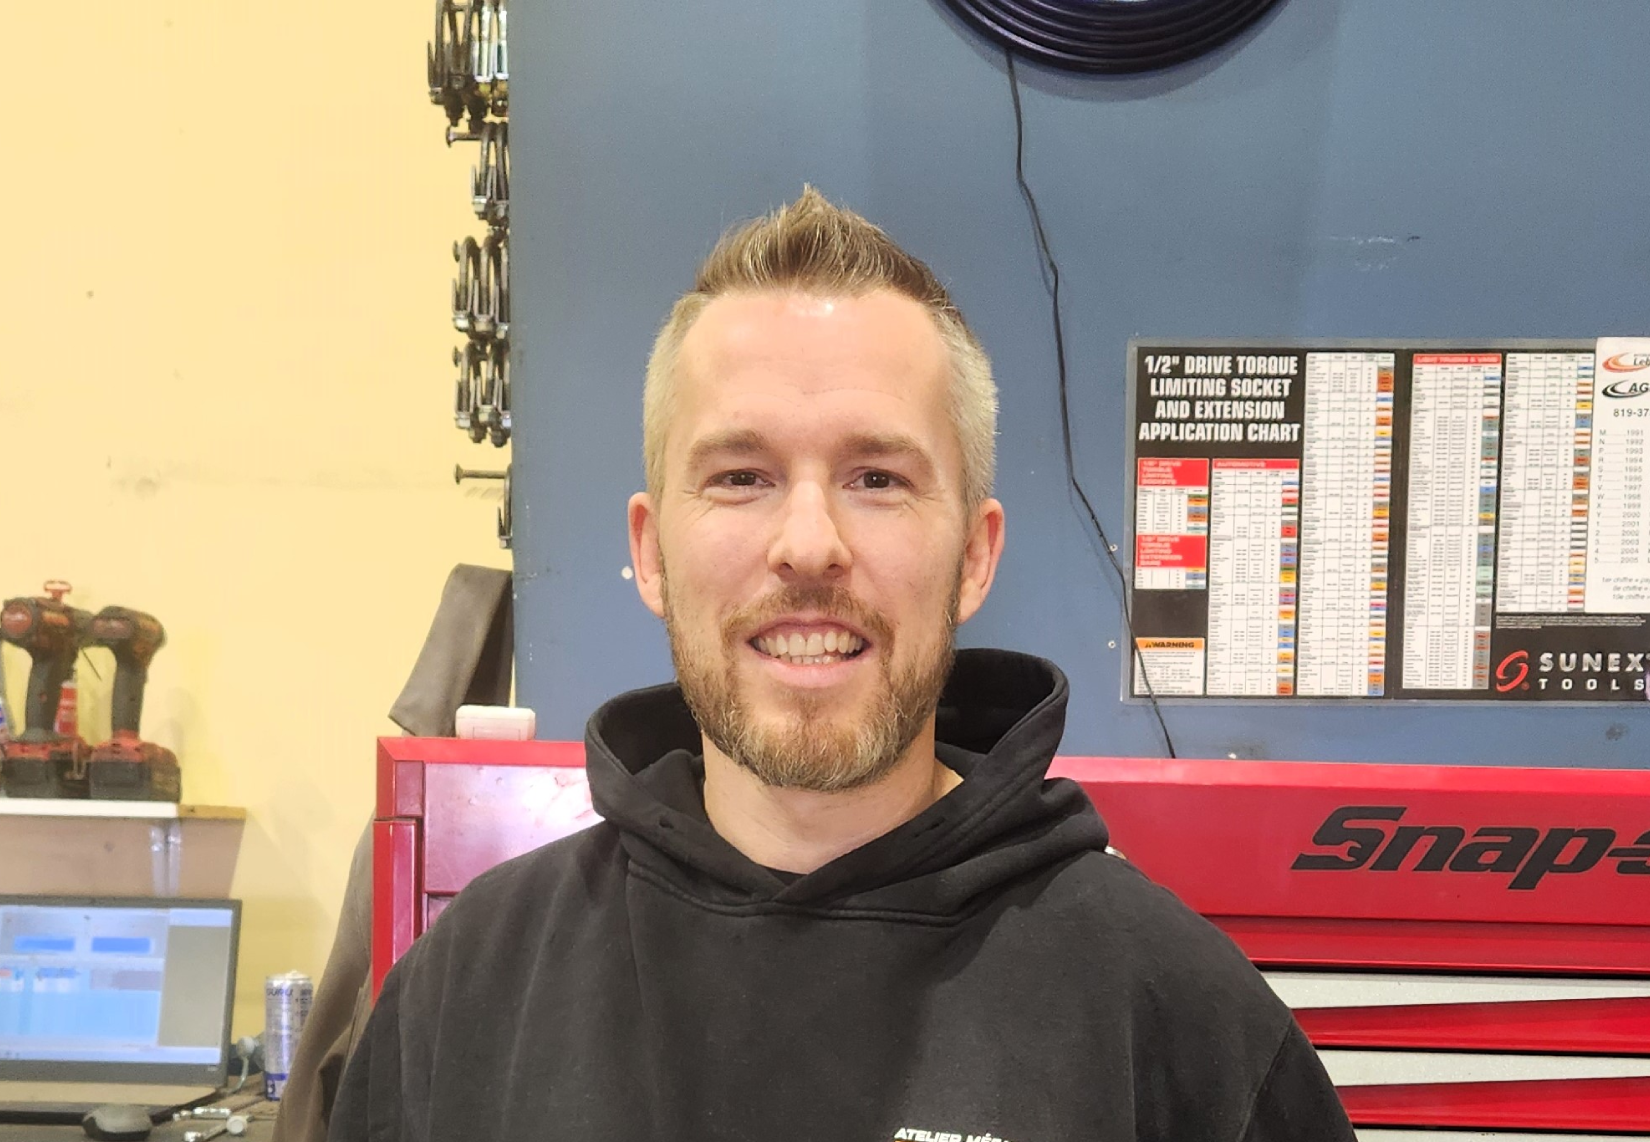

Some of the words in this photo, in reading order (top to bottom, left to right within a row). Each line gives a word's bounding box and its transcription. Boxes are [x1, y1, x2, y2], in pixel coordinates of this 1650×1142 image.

[1144, 355, 1180, 375] 1/2"
[1184, 355, 1232, 375] DRIVE
[1236, 356, 1298, 375] TORQUE
[1150, 378, 1227, 397] LIMITING
[1231, 378, 1292, 397] SOCKET
[1155, 401, 1190, 419] AND
[1194, 401, 1285, 419] EXTENSION
[1138, 422, 1243, 441] APPLICATION
[1247, 423, 1300, 442] CHART
[1539, 652, 1644, 672] SUNEX
[1538, 679, 1645, 691] TOOLS
